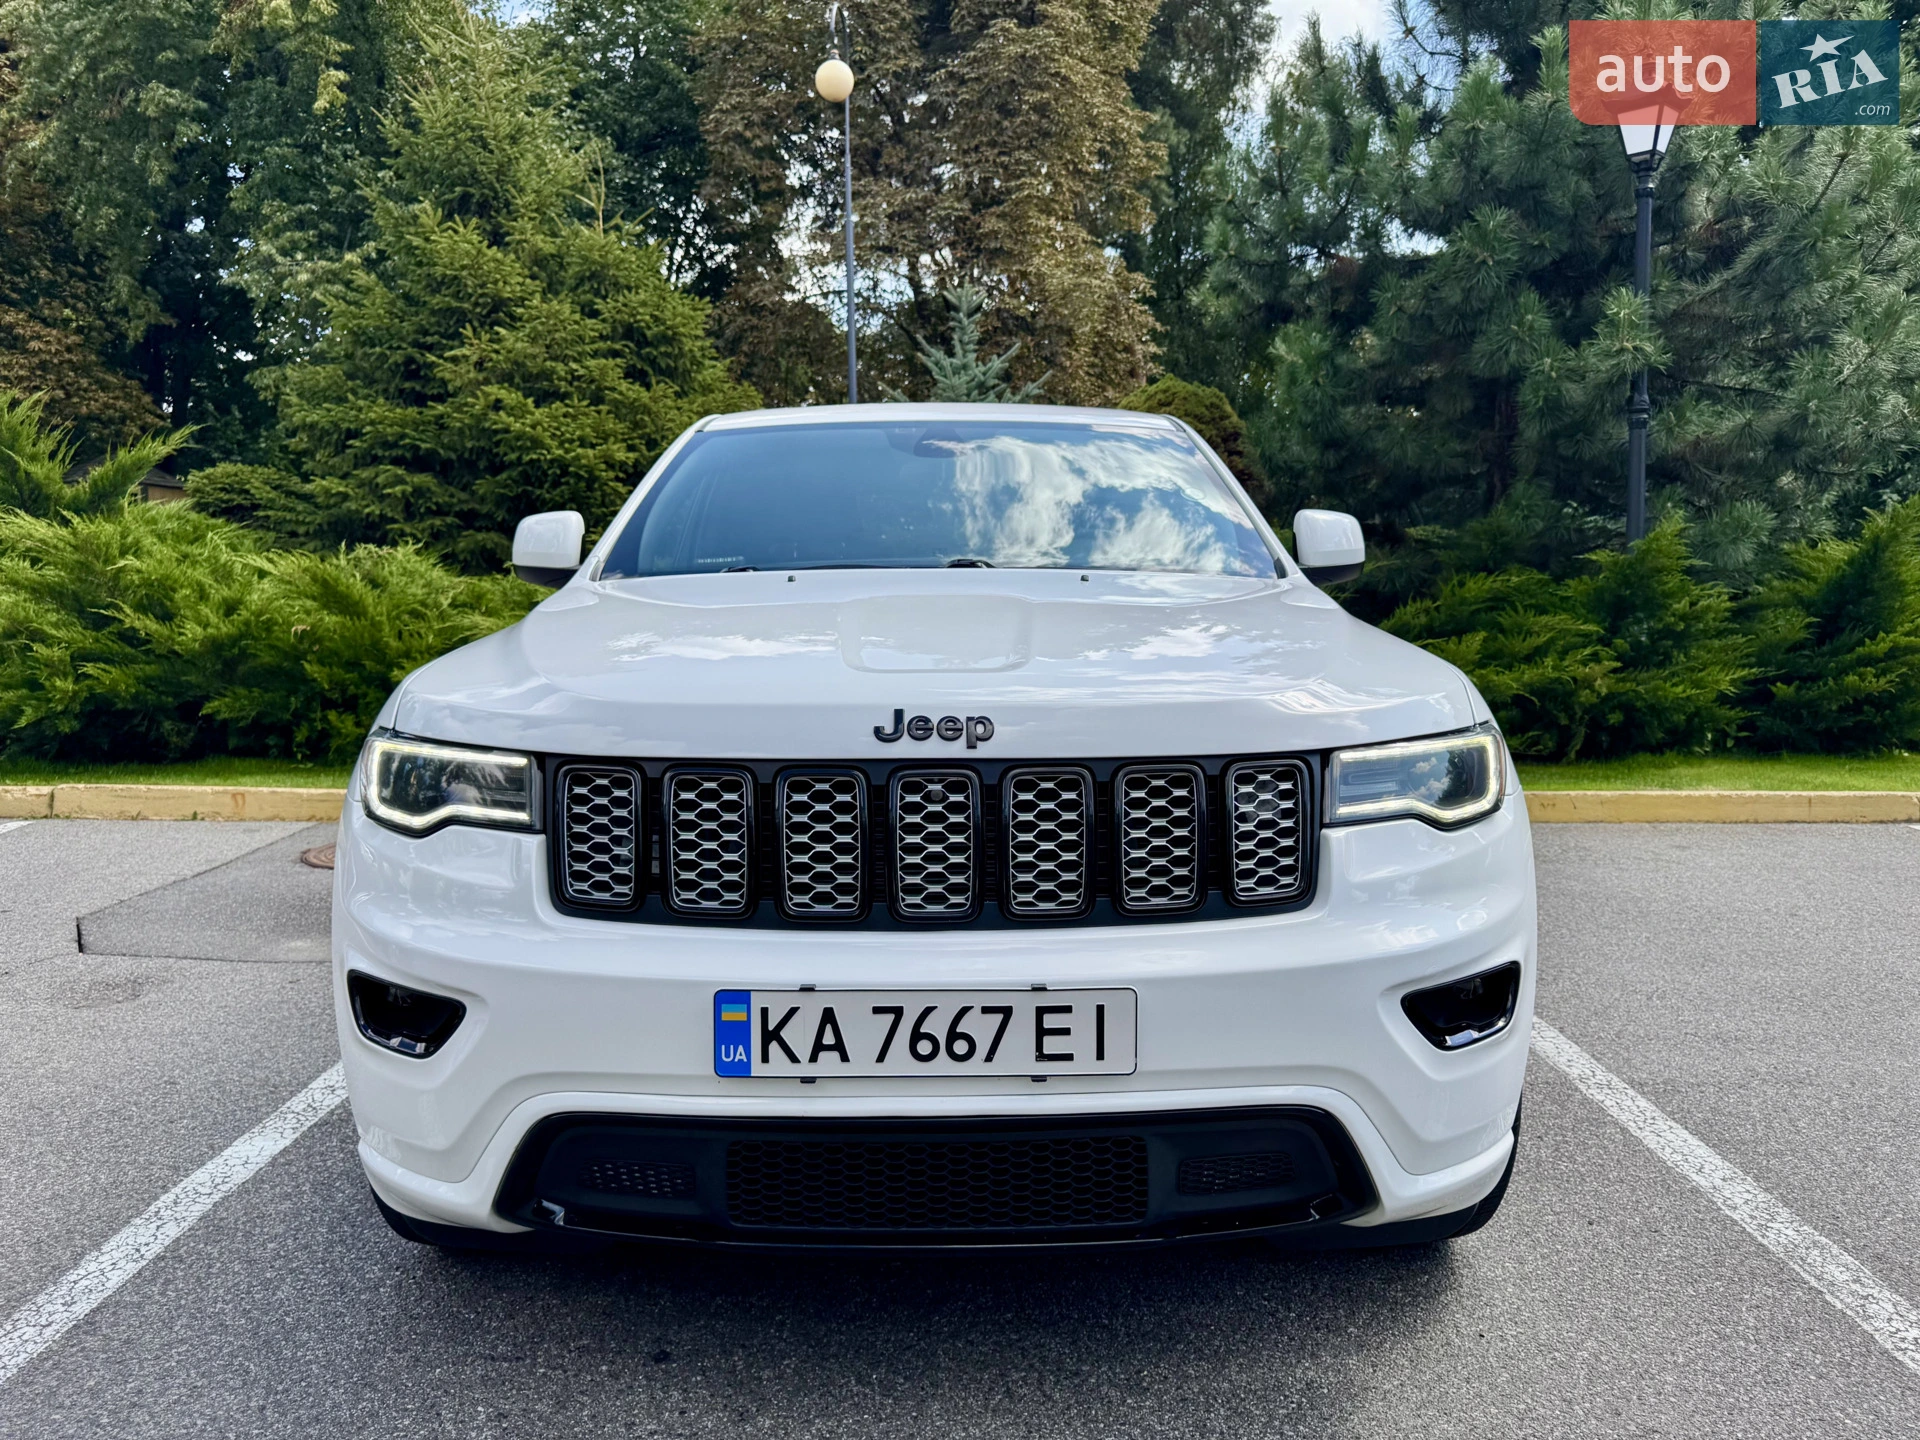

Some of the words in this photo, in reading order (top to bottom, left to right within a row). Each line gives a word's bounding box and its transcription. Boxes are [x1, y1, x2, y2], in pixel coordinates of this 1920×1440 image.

[873, 708, 995, 749] Jeep
[721, 1044, 748, 1063] UA
[760, 1005, 851, 1064] KA
[871, 1004, 1014, 1063] 7667
[1034, 1003, 1105, 1062] EI
